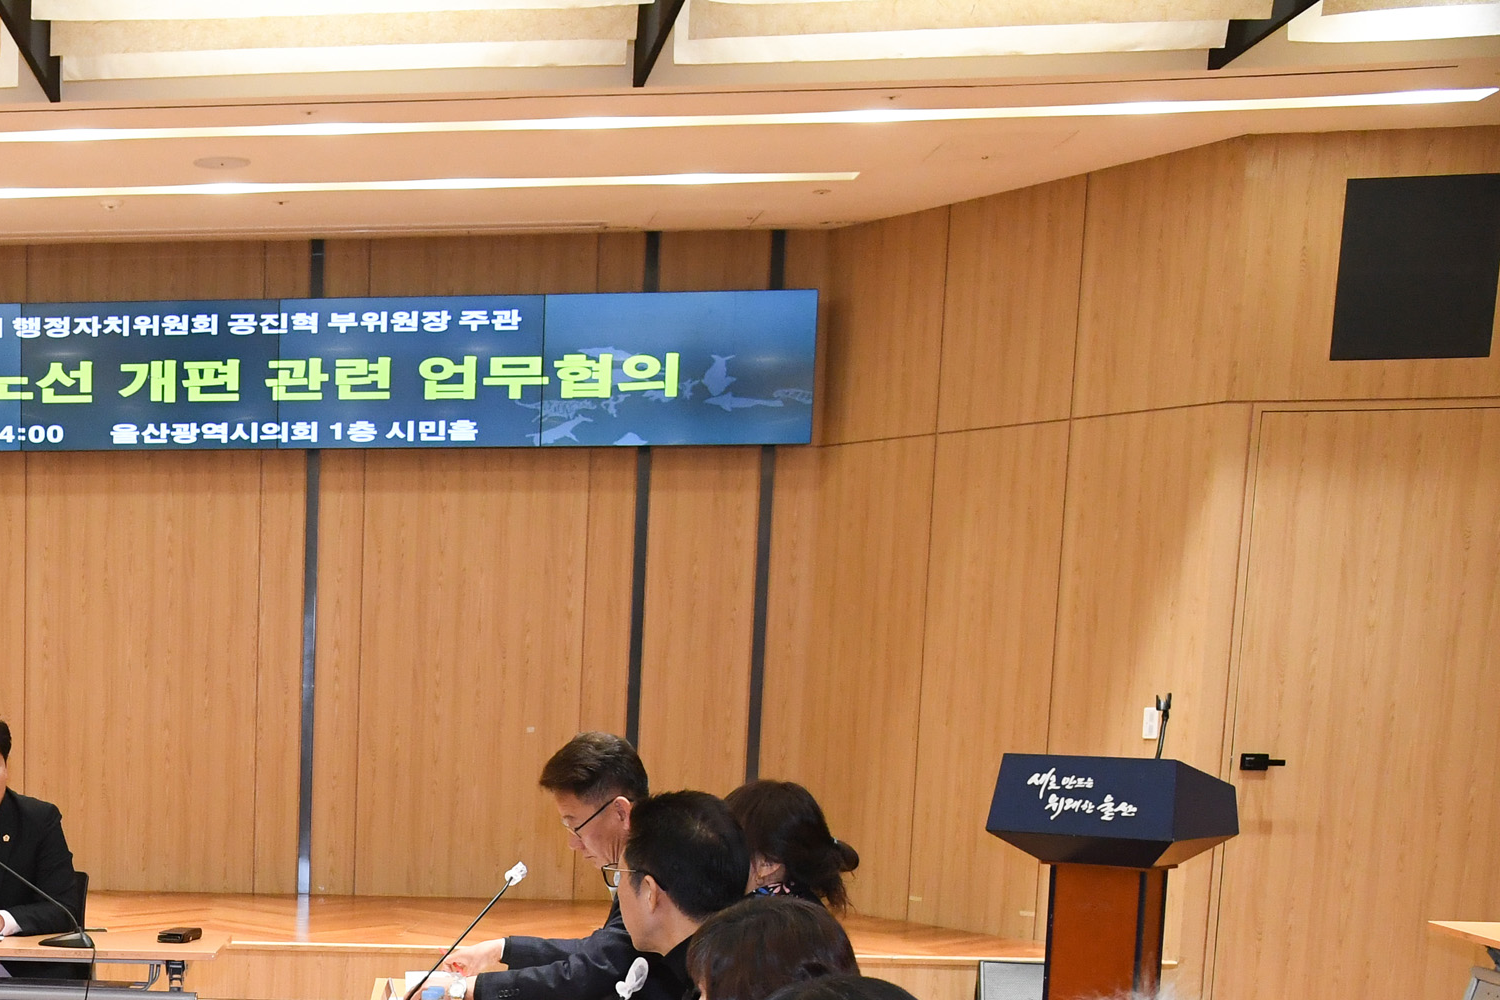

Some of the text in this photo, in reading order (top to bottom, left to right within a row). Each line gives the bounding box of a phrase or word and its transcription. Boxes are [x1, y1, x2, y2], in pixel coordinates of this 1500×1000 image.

[12, 314, 218, 340] 행정자치위원회
[227, 312, 319, 336] 공진혁
[327, 310, 452, 334] 부위원장
[458, 309, 522, 332] 주관
[119, 358, 241, 404] 개편
[266, 356, 393, 402] 관련
[417, 352, 681, 401] 업무협의
[109, 422, 318, 445] 울산광역시의회
[329, 420, 378, 443] 1층
[385, 419, 479, 442] 시민홀
[1026, 767, 1094, 800] 새로 만드는
[1044, 793, 1138, 821] 위대한 울산
